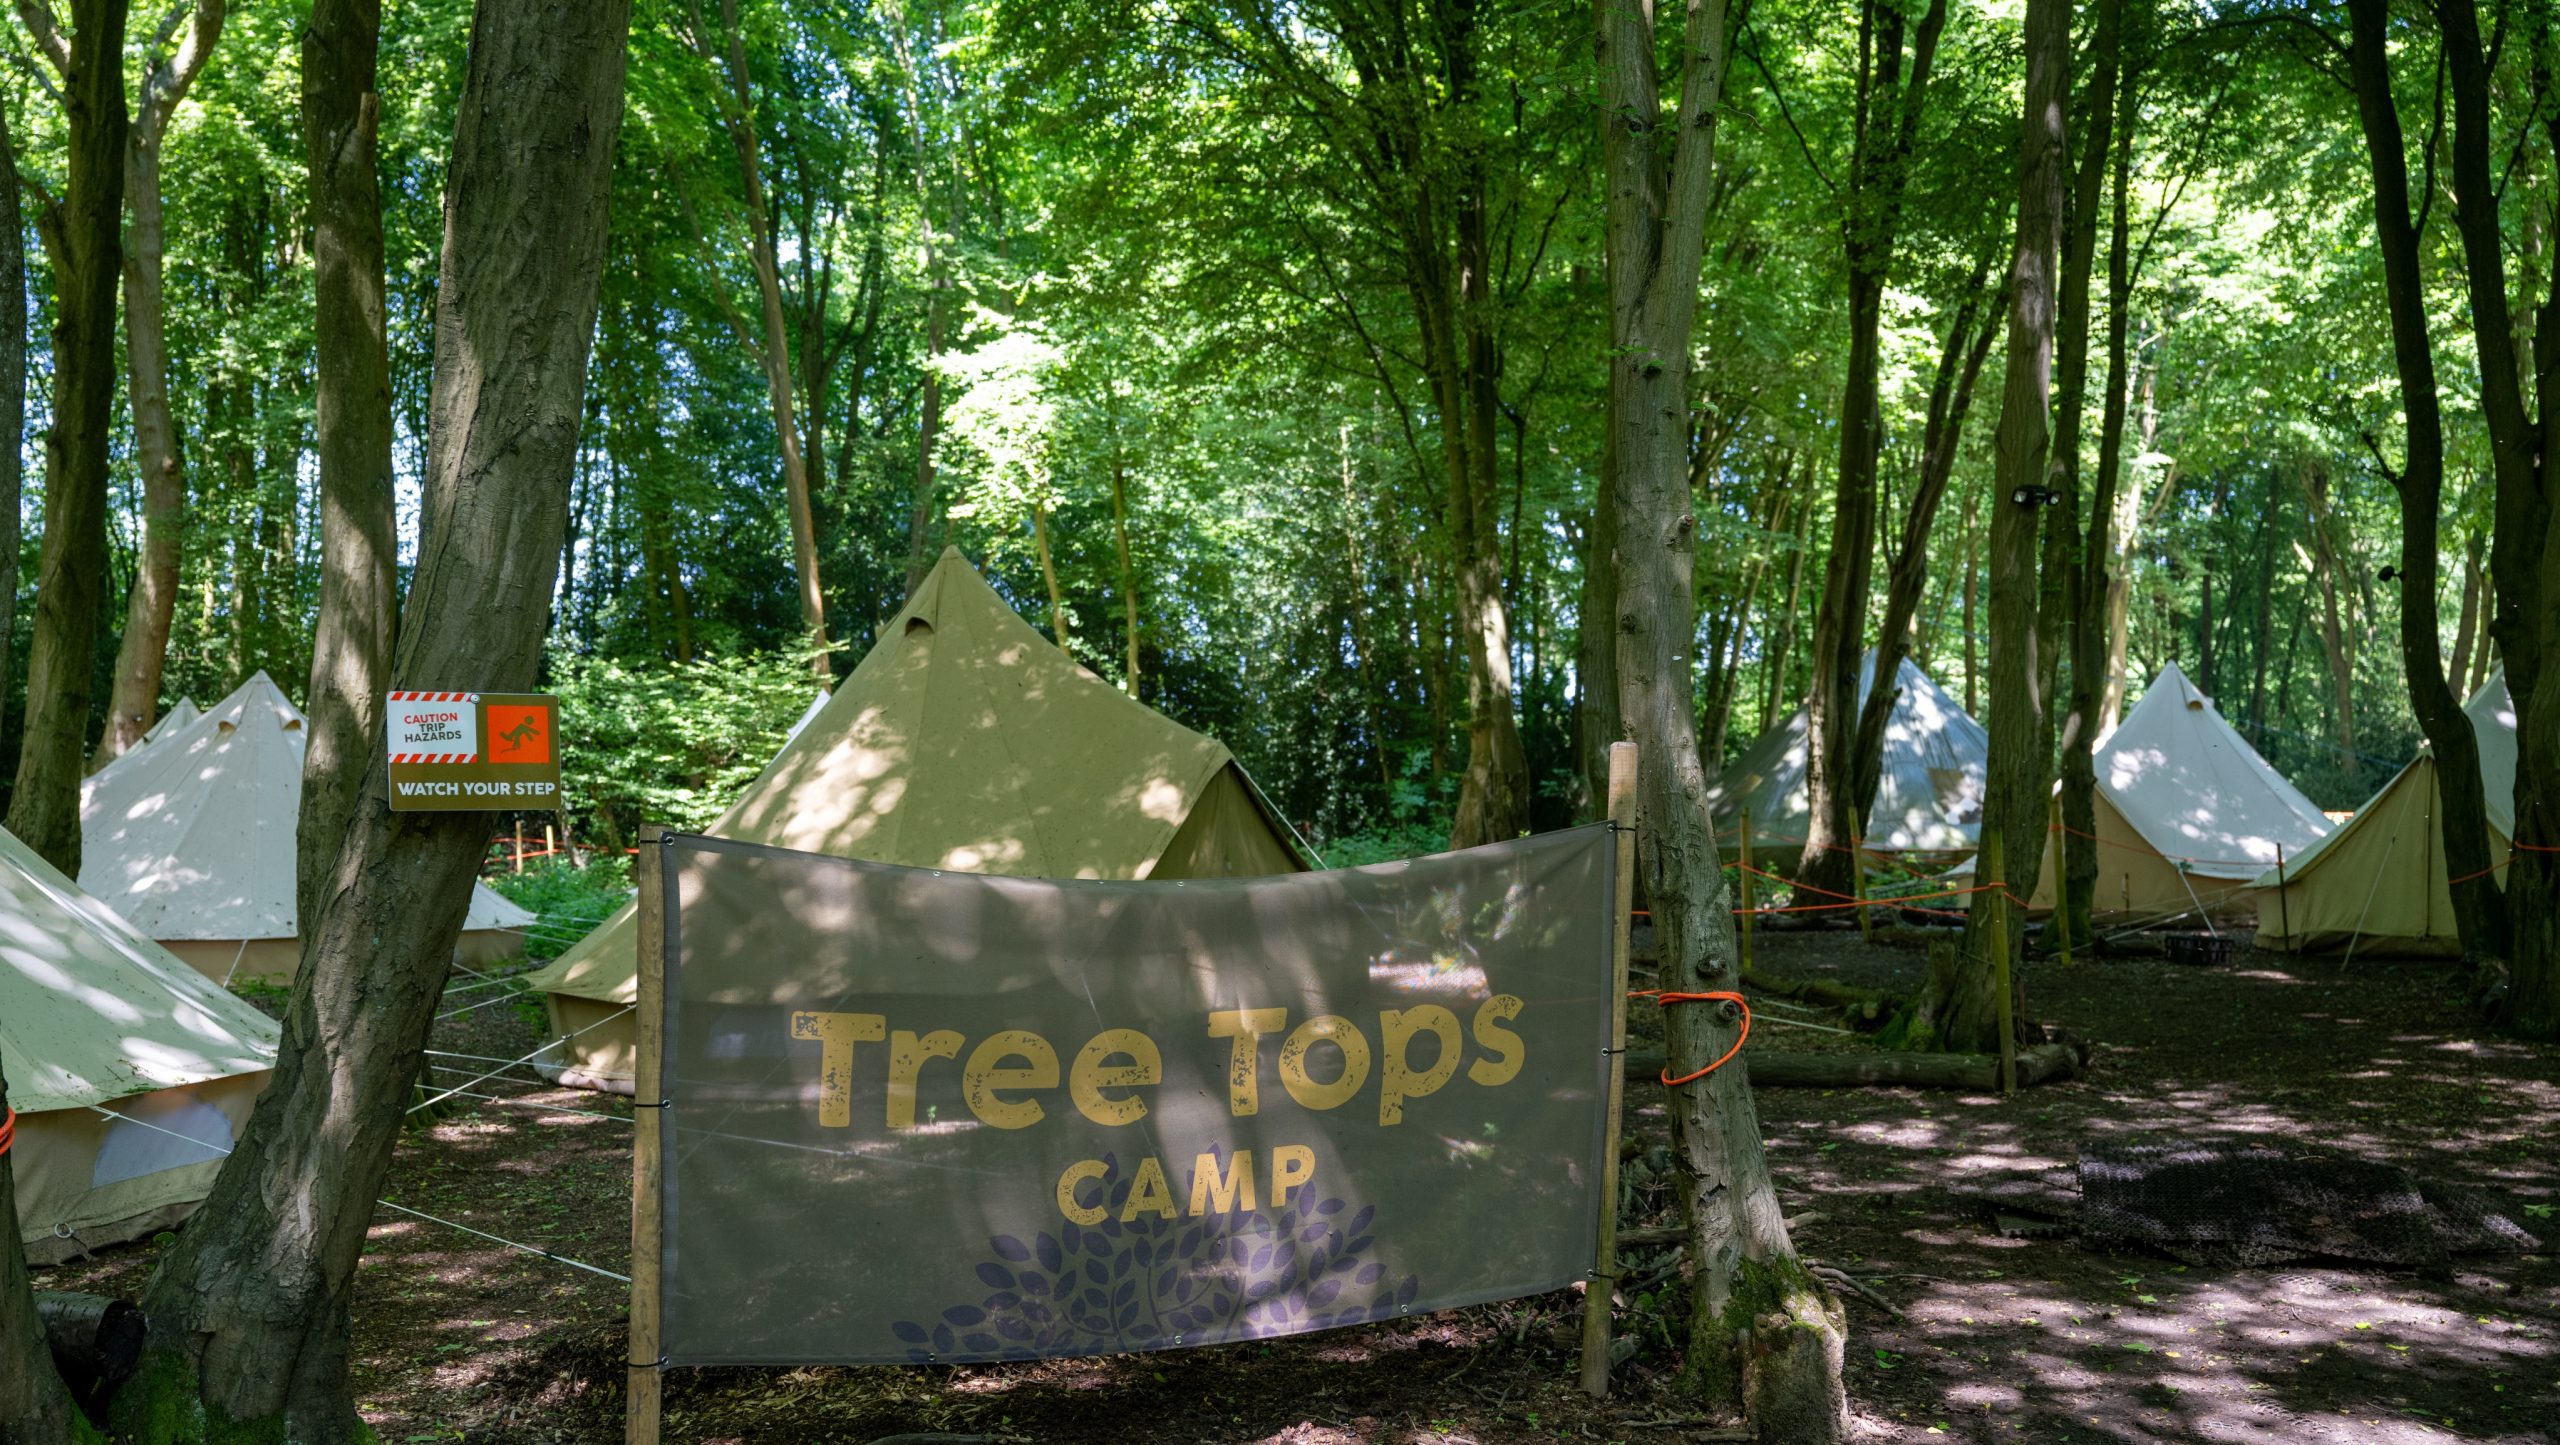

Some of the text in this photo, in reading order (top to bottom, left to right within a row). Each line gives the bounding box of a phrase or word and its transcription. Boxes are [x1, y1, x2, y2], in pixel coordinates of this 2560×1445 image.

[404, 713, 458, 724] CAUTION
[419, 722, 445, 732] TRIP
[404, 730, 462, 743] HAZARDS
[397, 782, 556, 796] WATCH YOUR STEP
[790, 993, 1525, 1130] Tree Tops
[1056, 1144, 1316, 1226] CAMP
